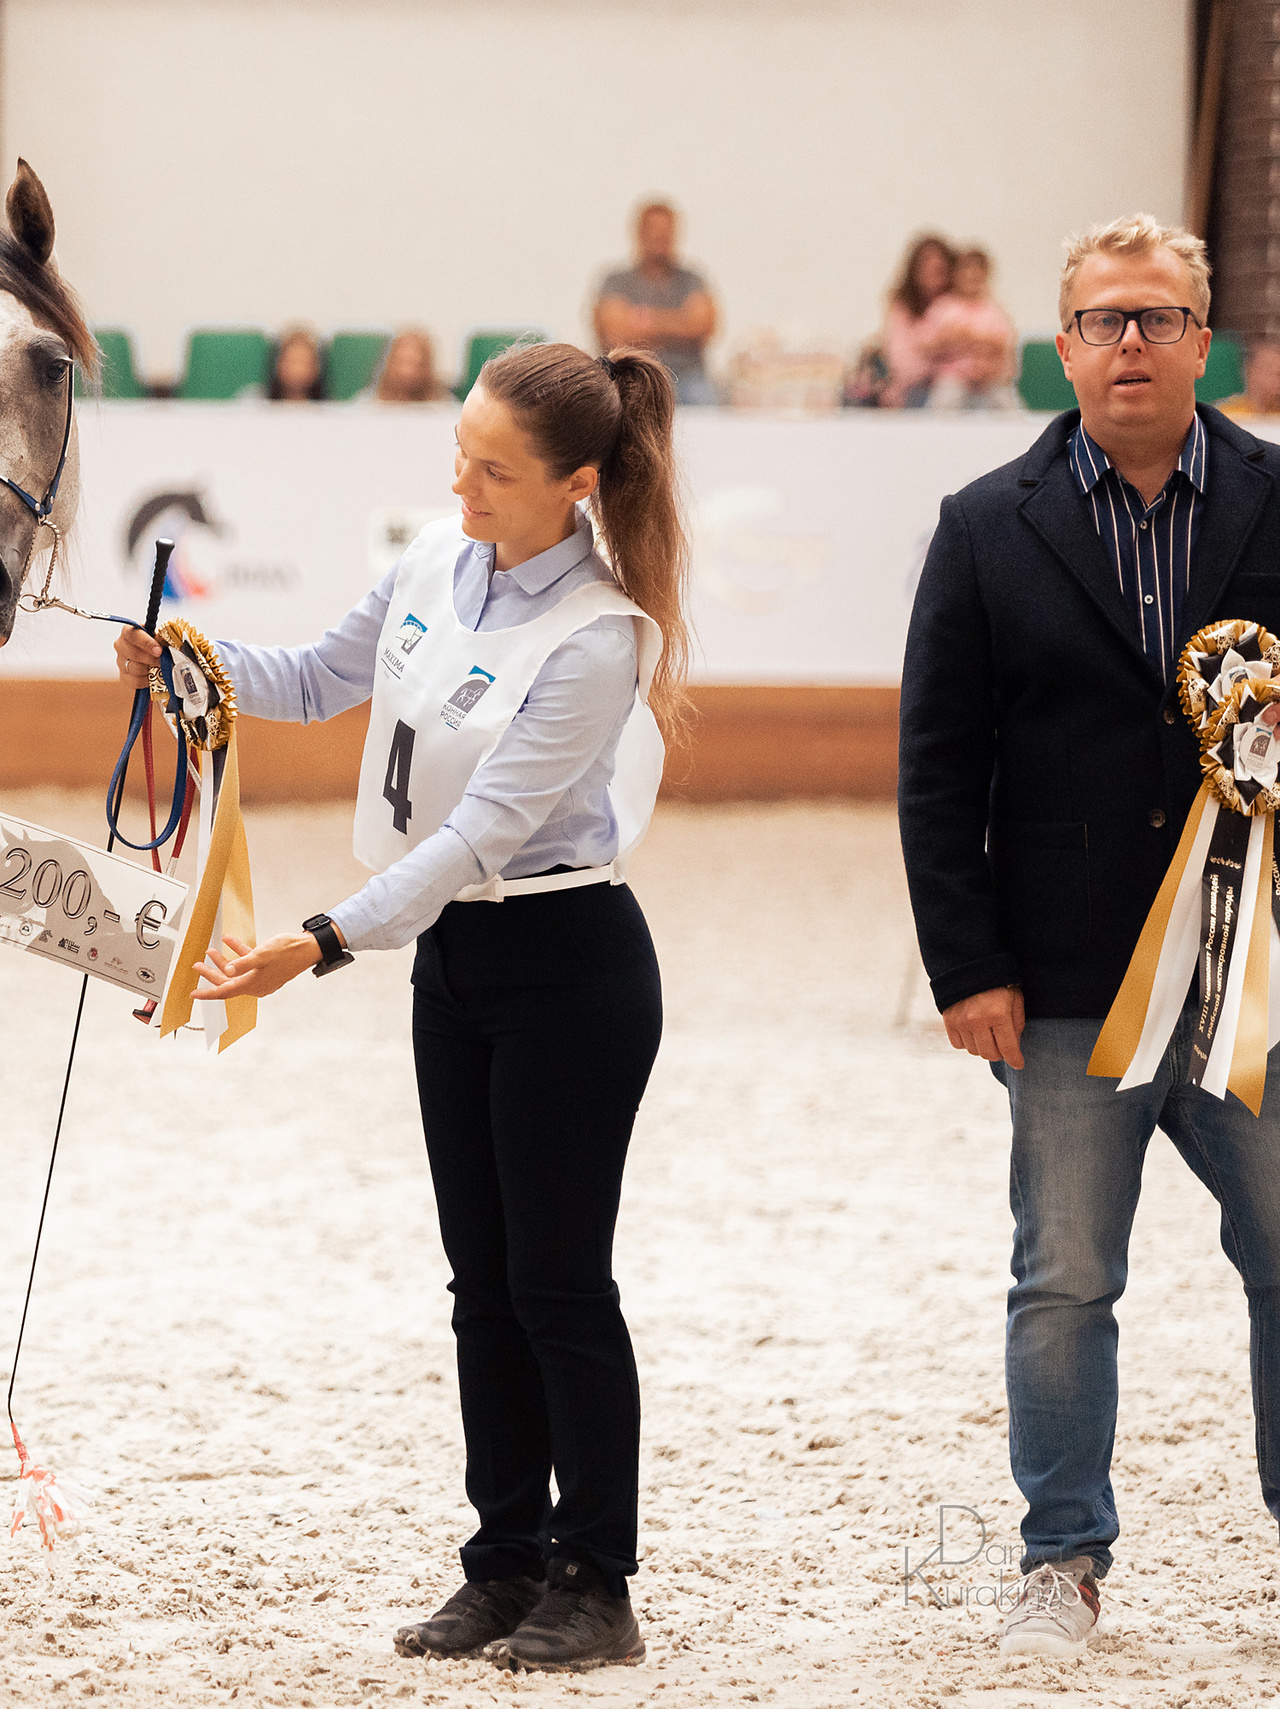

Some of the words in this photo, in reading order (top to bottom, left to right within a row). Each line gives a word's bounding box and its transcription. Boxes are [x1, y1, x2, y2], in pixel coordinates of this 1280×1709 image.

[384, 647, 405, 673] MAXIMA
[440, 710, 461, 728] РОССИЯ
[443, 702, 466, 719] КОННАЯ
[383, 718, 416, 835] 4
[1210, 874, 1219, 917] лошадей
[1206, 915, 1217, 951] России
[1204, 951, 1212, 1003] Чемпионат
[1207, 993, 1221, 1039] арабской
[1216, 924, 1230, 992] чистокровной
[1224, 886, 1235, 924] породы
